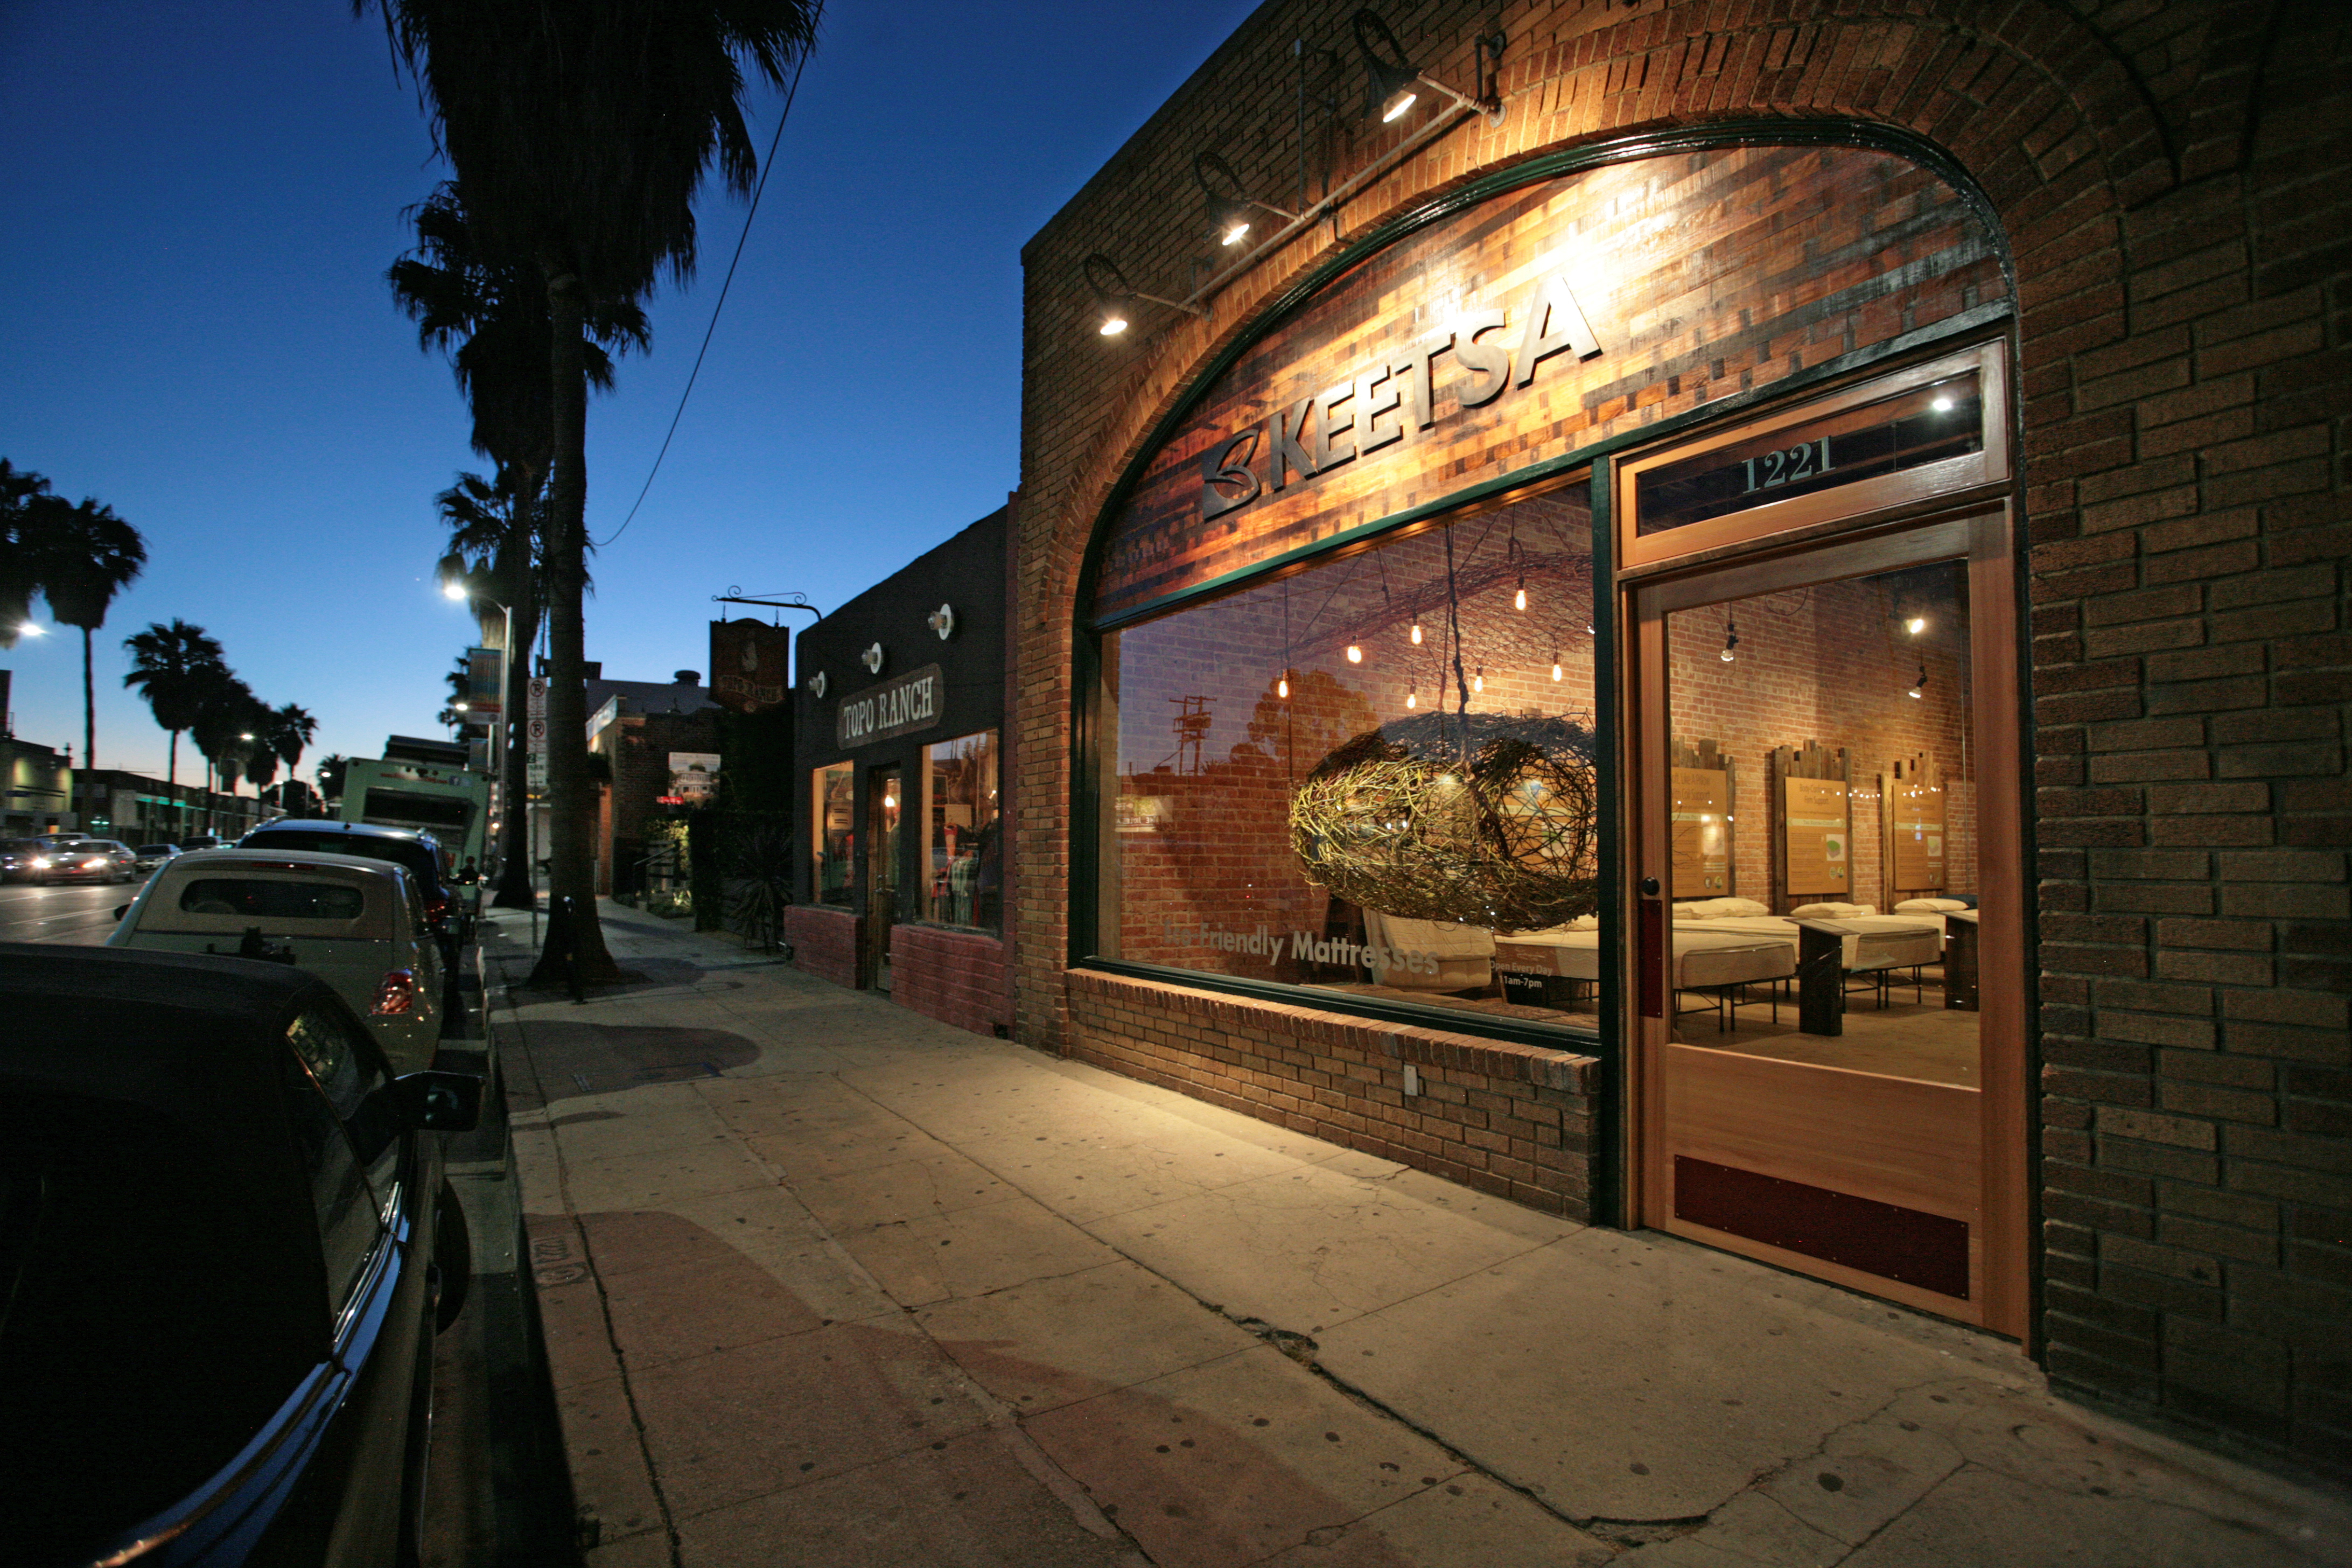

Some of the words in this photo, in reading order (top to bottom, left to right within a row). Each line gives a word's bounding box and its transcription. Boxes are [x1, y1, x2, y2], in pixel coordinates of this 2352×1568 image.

[1269, 273, 1602, 492] KEETSA
[1741, 435, 1837, 494] 1221
[844, 698, 874, 739] TOPO
[878, 676, 934, 730] RANCH
[1163, 919, 1284, 967] Eco-Friendly
[1292, 930, 1439, 975] Mattresses
[1490, 960, 1510, 971] Open
[1512, 962, 1535, 975] Every
[1536, 964, 1553, 977] Day
[1499, 975, 1542, 989] 11am-7pm
